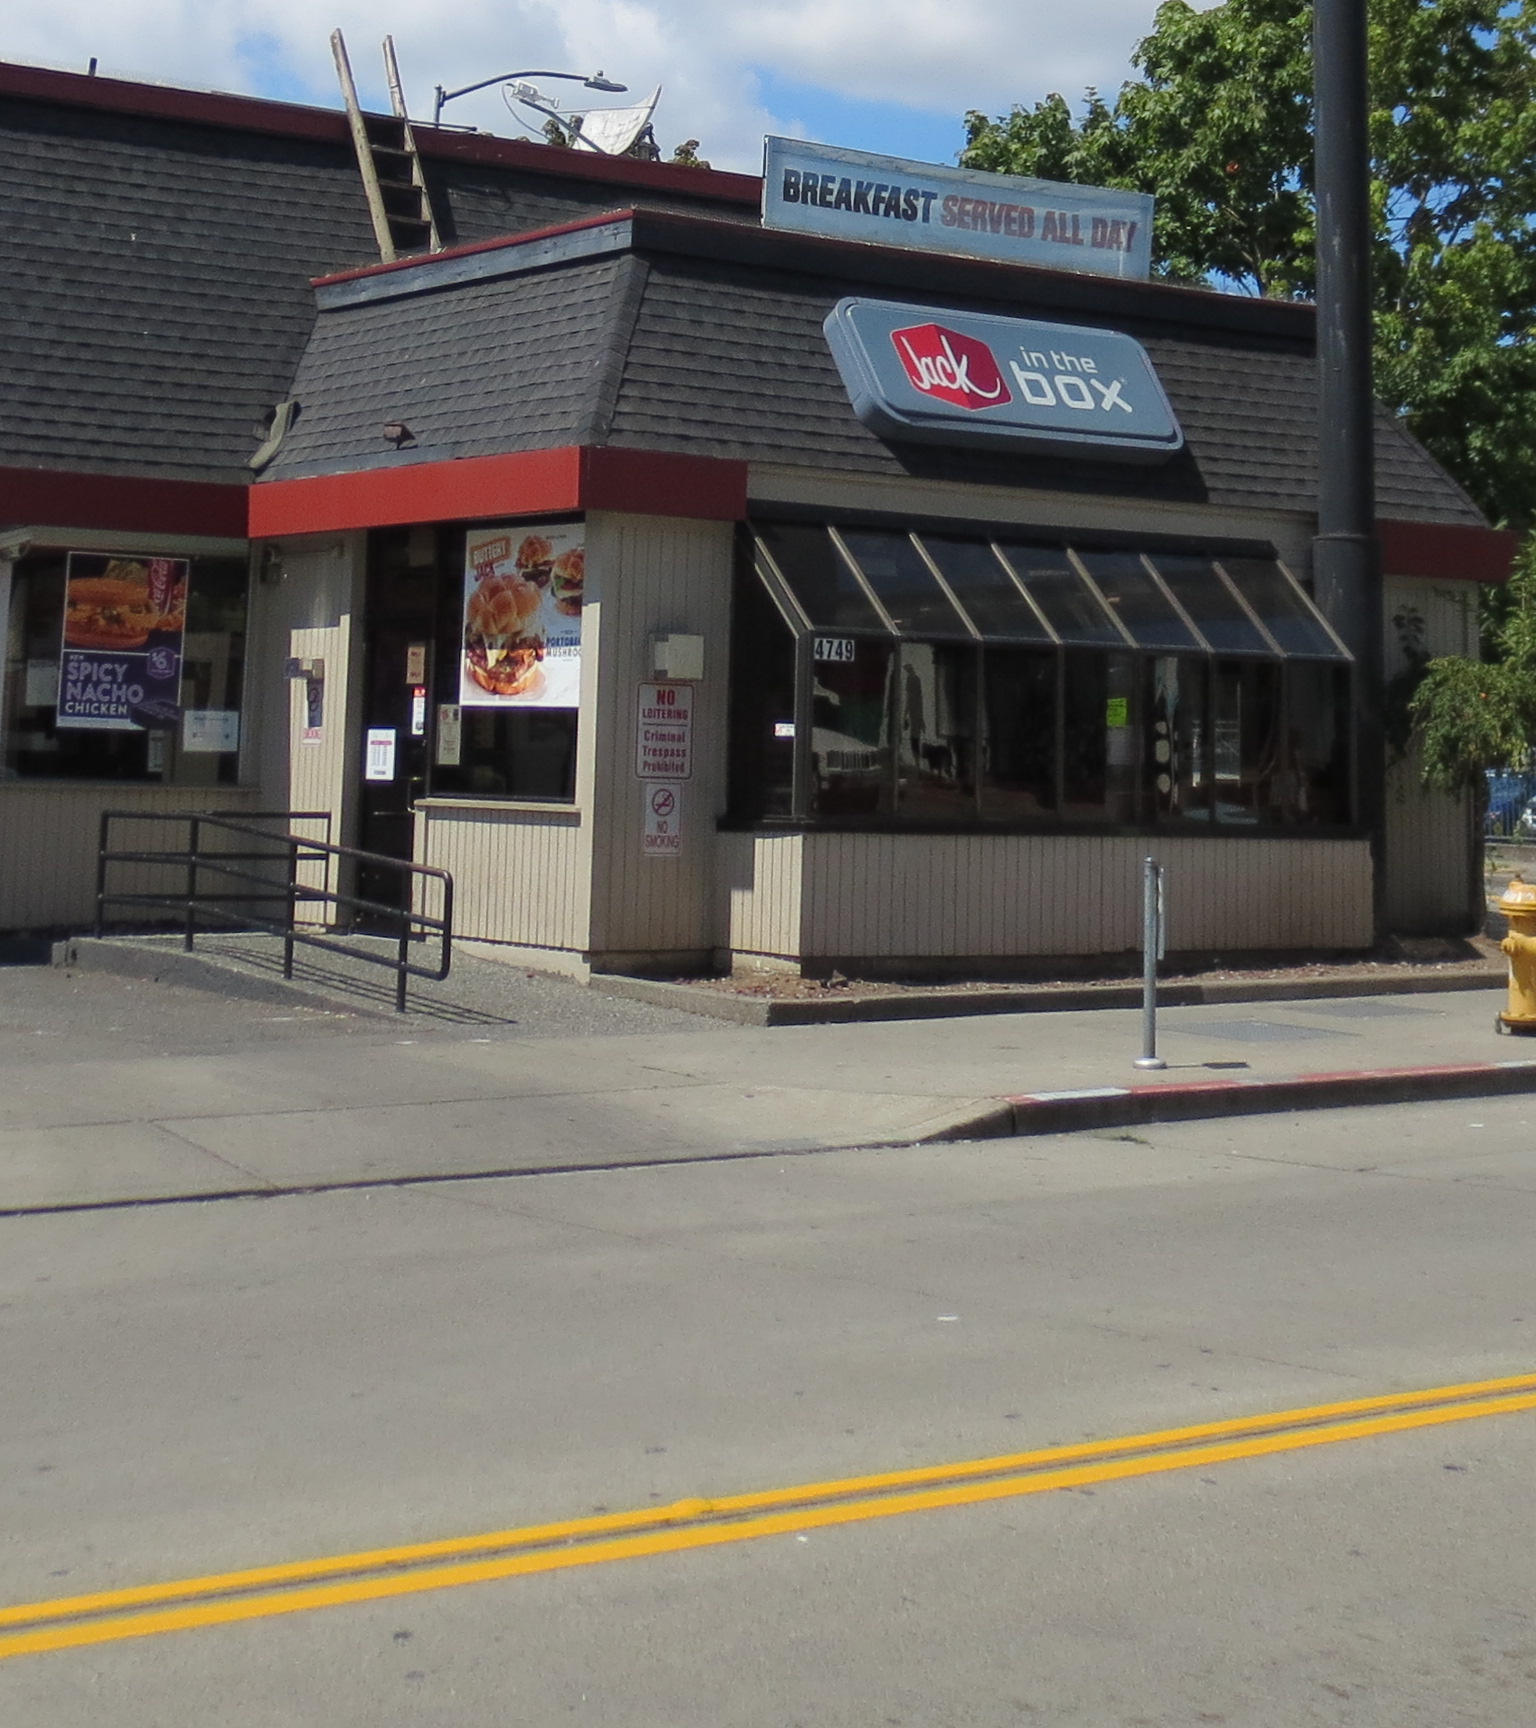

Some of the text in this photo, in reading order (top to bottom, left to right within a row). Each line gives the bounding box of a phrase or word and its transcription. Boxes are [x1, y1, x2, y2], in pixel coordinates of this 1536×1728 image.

[782, 167, 1138, 253] BREAKFAST SERVED ALL DAY
[901, 334, 1001, 399] Jack
[1020, 345, 1098, 374] in the
[1009, 360, 1133, 414] box
[815, 639, 853, 660] 4749
[67, 661, 128, 682] SPICY
[66, 681, 144, 704] NACHO
[656, 689, 676, 706] NO
[65, 701, 128, 715] CHICKEN
[642, 707, 688, 720] LOITERING
[643, 729, 685, 743] Criminal
[642, 745, 687, 759] Trespass
[642, 760, 685, 773] Prohibited
[657, 820, 668, 833] NO
[645, 834, 679, 848] SMOKING
